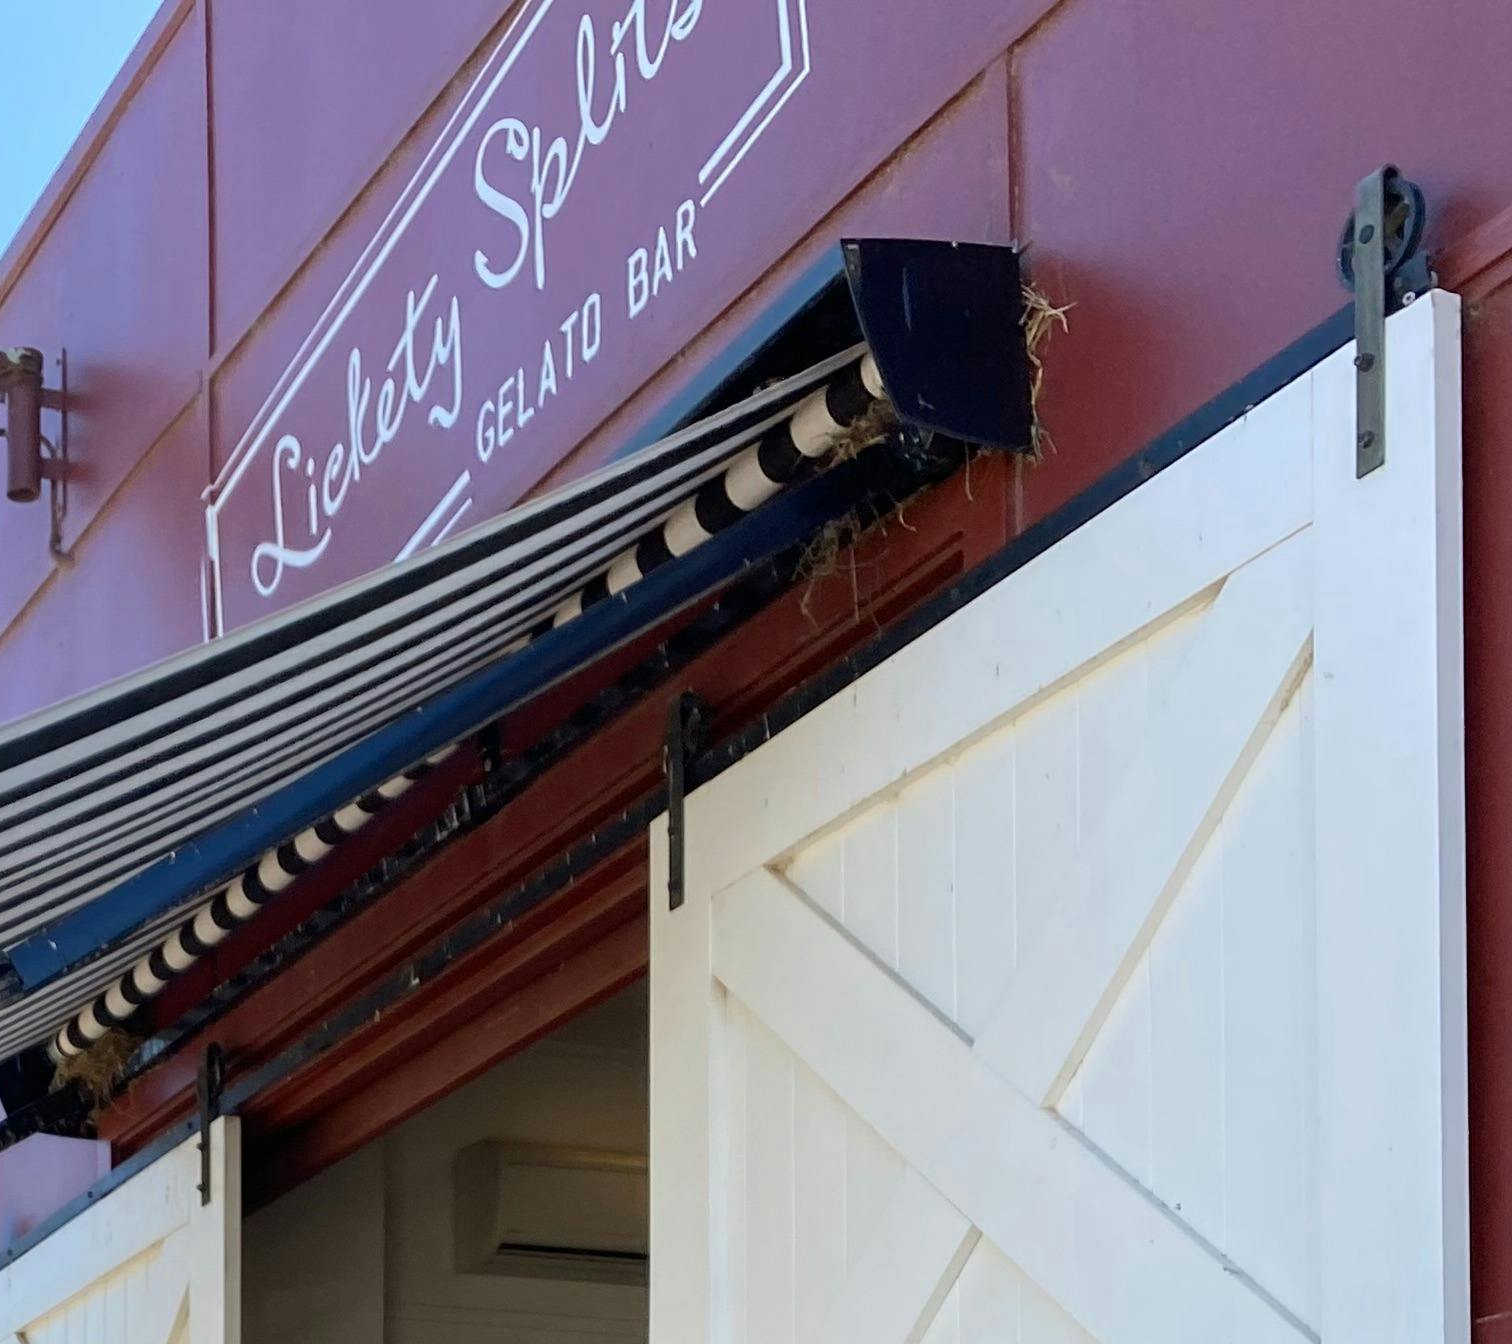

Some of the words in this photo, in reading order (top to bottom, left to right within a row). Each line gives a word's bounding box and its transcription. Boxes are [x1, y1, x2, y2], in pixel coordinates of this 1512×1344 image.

[250, 273, 462, 596] Lickety
[476, 293, 600, 463] GELATO
[627, 199, 697, 320] BAR
